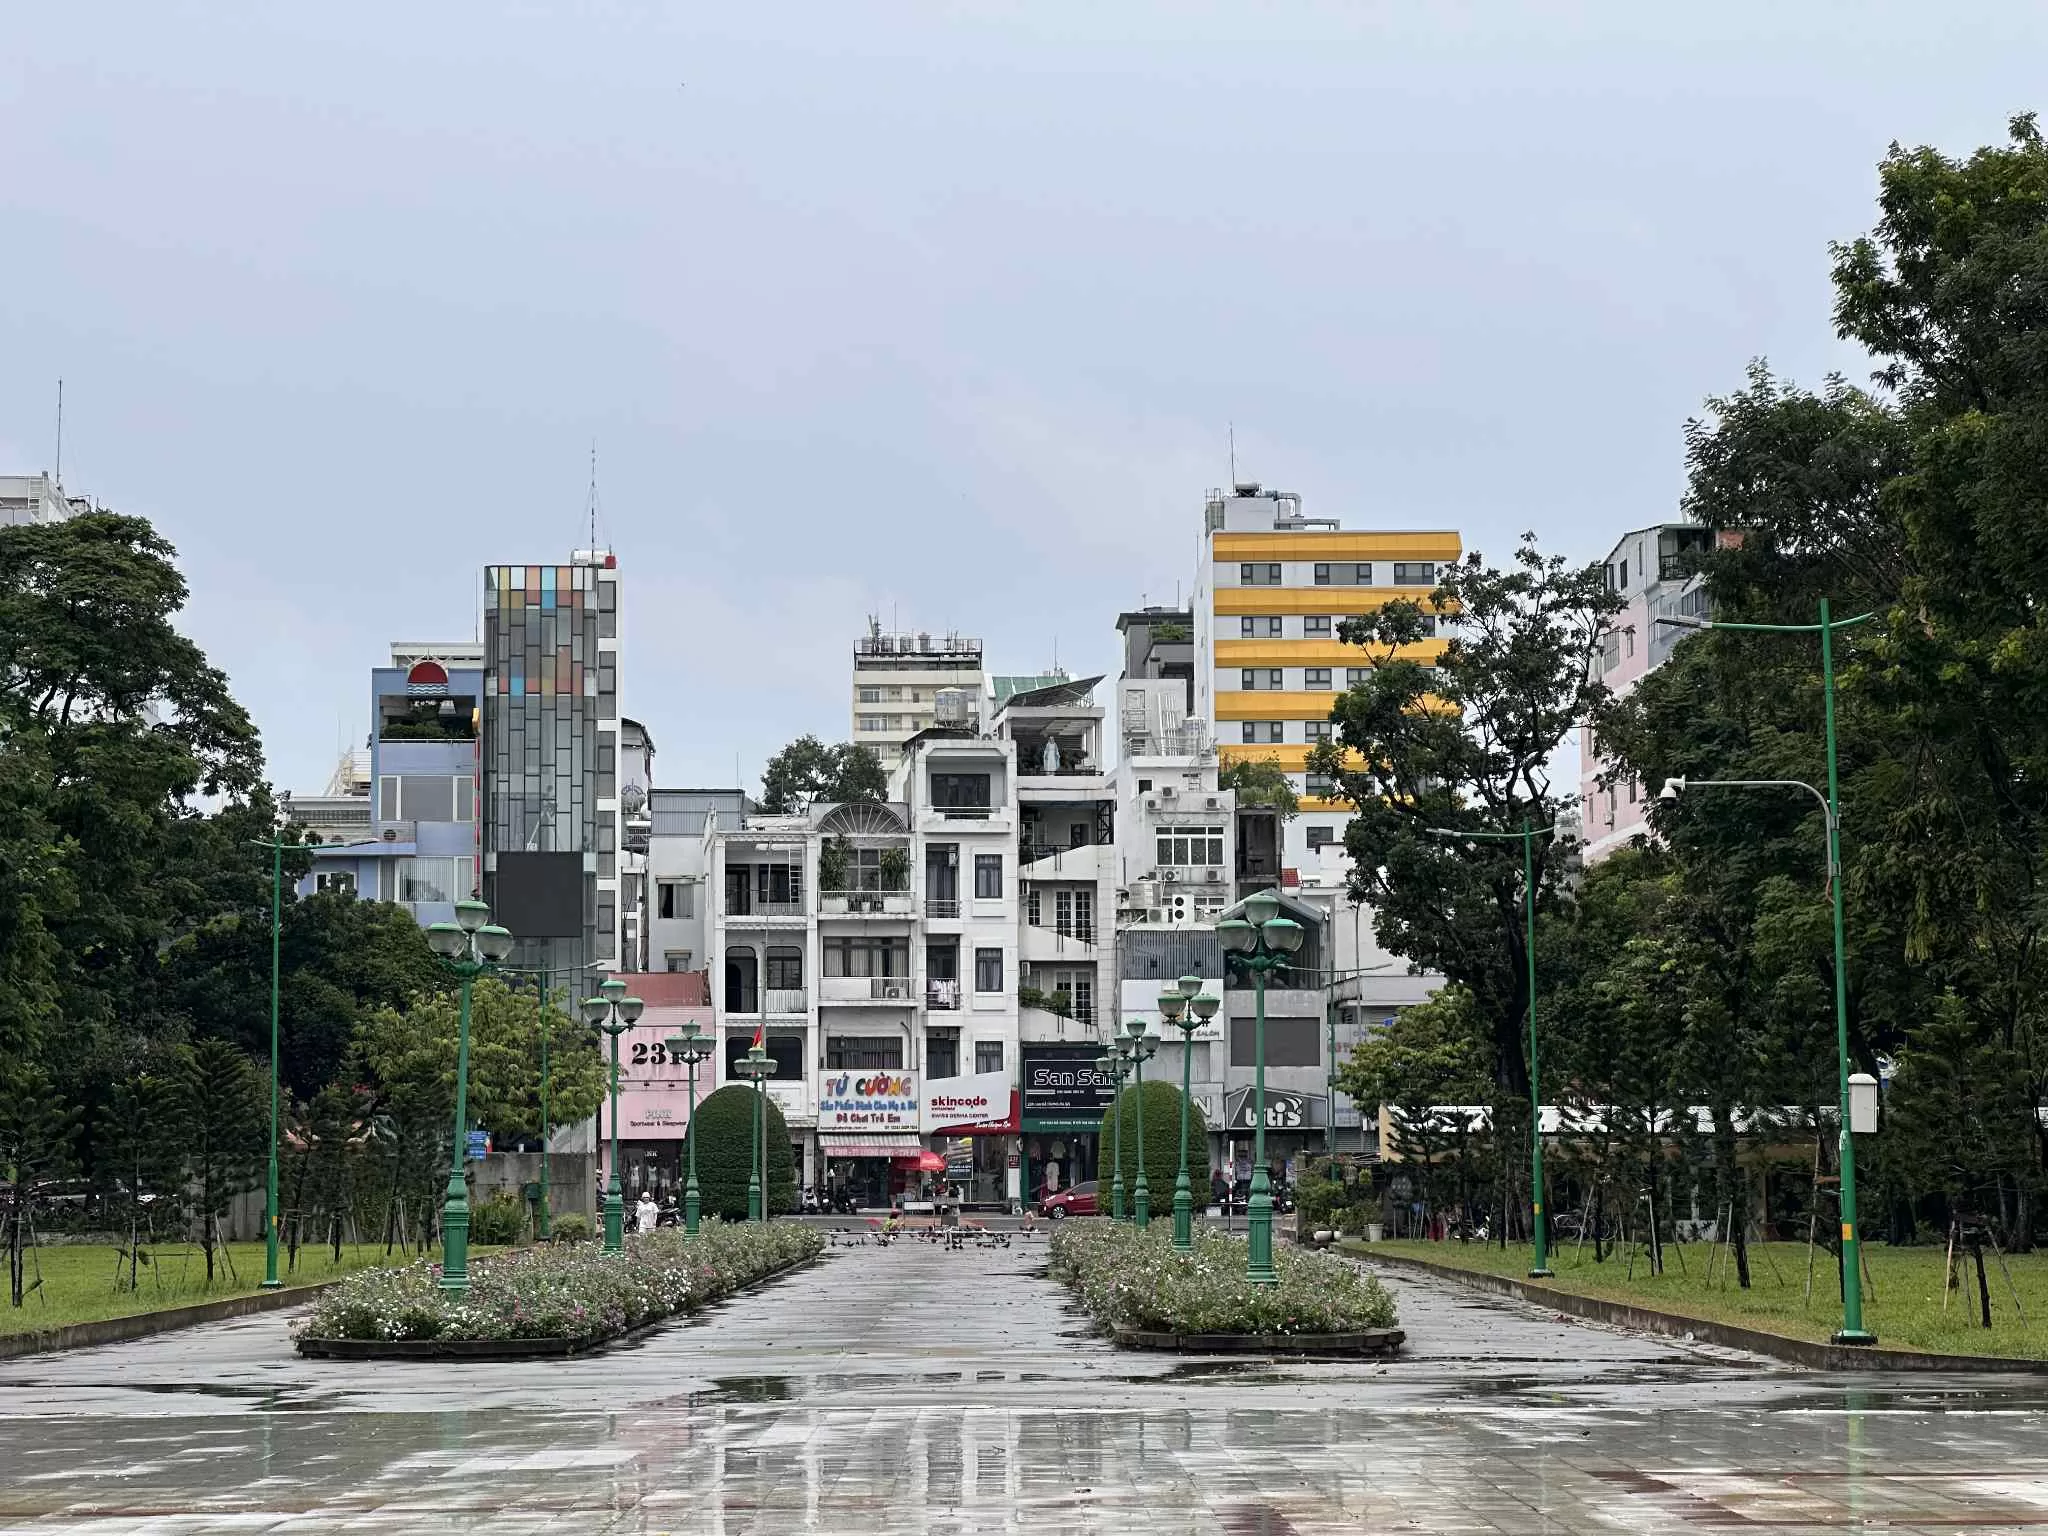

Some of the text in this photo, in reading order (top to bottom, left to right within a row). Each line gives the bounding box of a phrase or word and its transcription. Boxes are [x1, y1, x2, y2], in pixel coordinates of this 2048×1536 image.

[855, 1071, 912, 1096] CƯỜNG
[1033, 1068, 1075, 1086] San
[931, 1095, 988, 1107] skincode
[887, 1112, 901, 1123] Em
